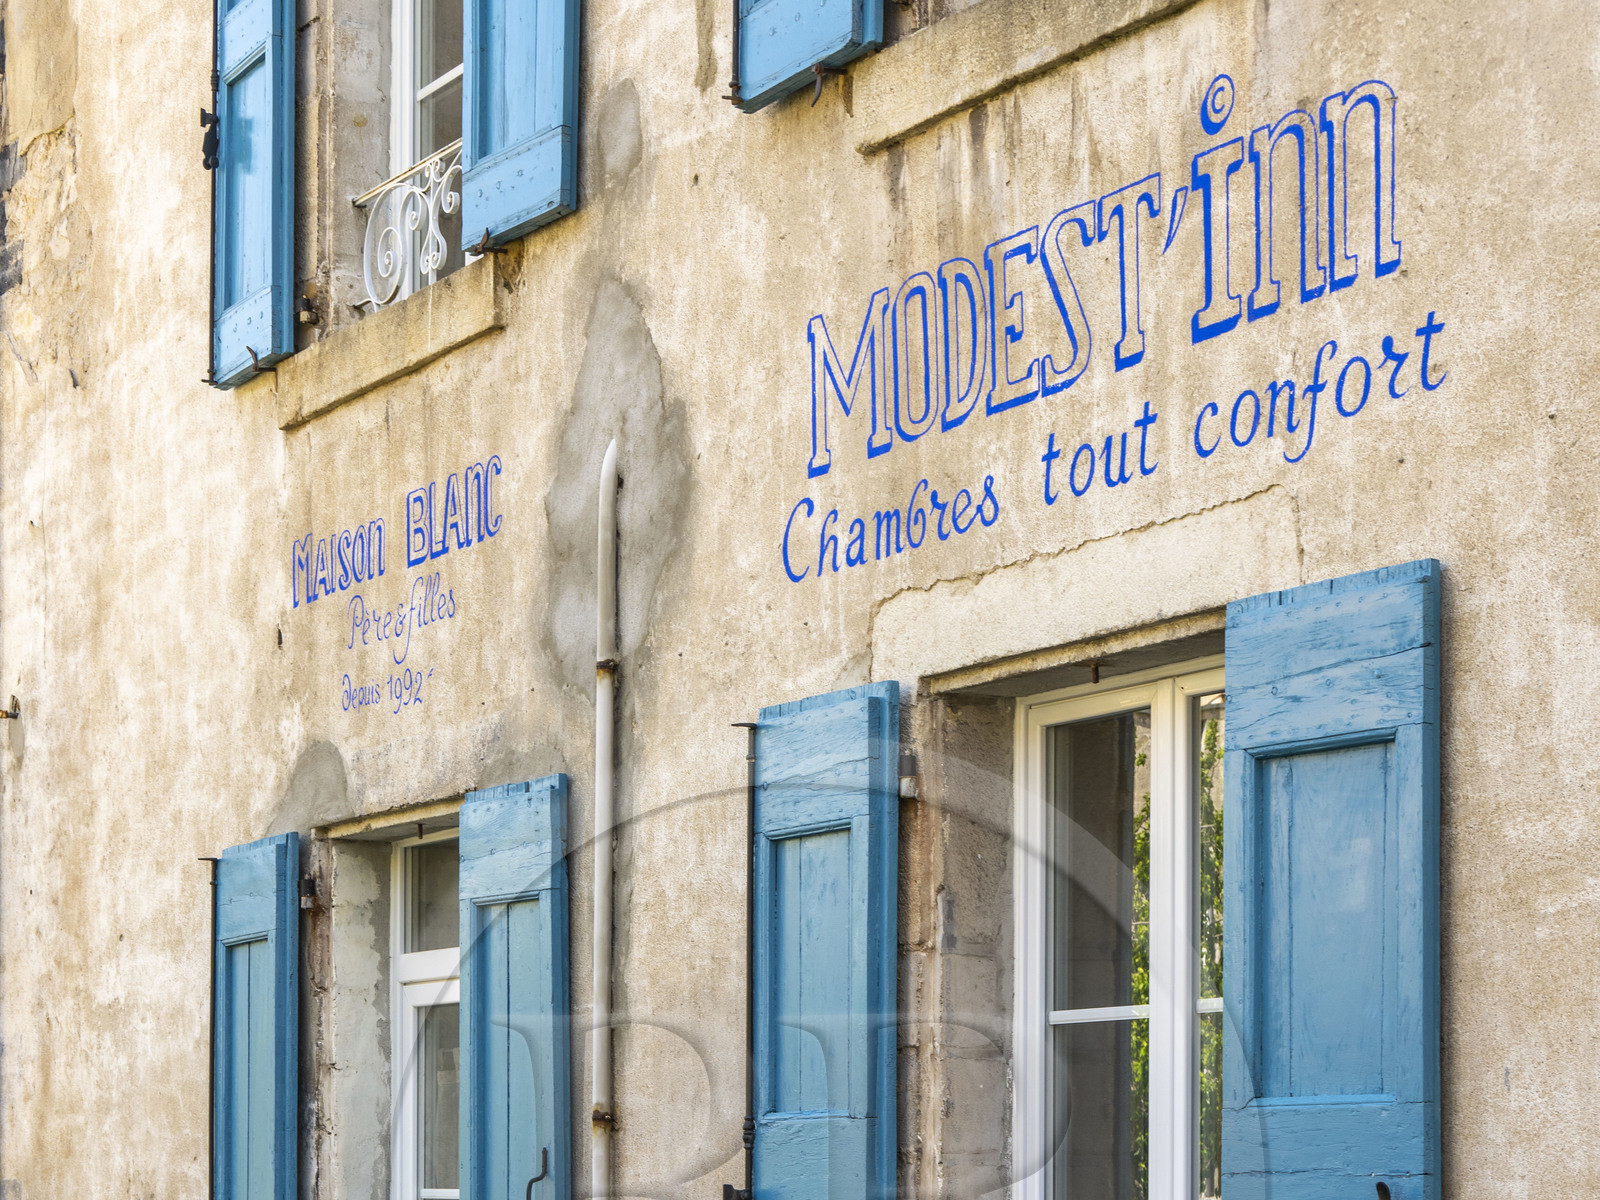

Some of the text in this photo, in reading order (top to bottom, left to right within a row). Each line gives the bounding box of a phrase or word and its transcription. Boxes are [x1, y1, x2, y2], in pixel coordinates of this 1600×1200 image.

[782, 310, 1448, 583] Chambres tout confort
[341, 673, 381, 713] depuis
